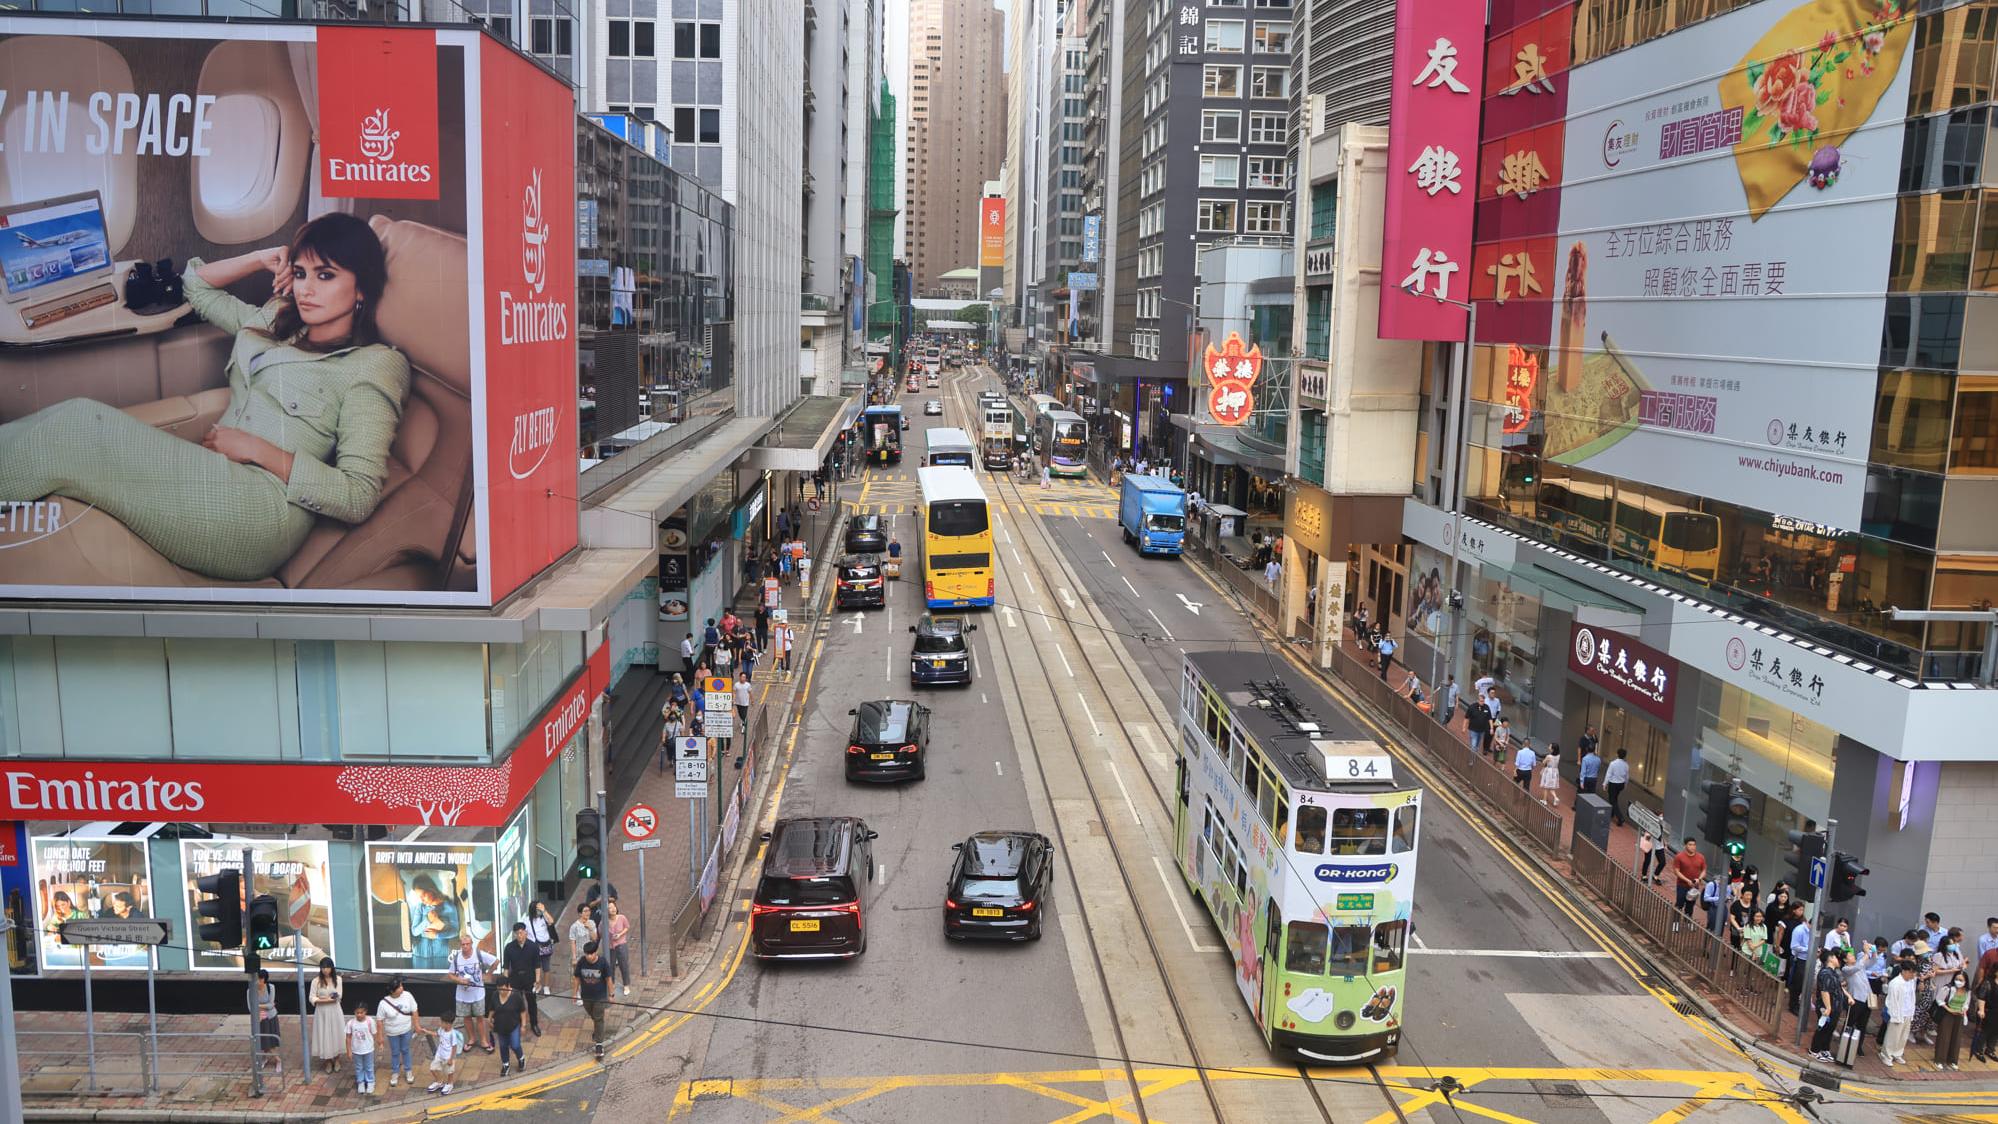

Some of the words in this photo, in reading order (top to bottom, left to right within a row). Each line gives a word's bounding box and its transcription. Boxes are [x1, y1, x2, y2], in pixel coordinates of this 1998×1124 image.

[1179, 5, 1199, 54] 錦記
[24, 90, 69, 153] IN
[86, 91, 216, 157] SPACE
[1660, 107, 1744, 159] 財富管理
[329, 158, 431, 182] Emirates
[1401, 37, 1471, 303] 友銀行
[1605, 217, 1734, 258] 全方位綜合服務
[1643, 261, 1787, 297] 照顧您全面需要
[500, 290, 567, 345] Emirates
[1215, 386, 1247, 418] 押
[1639, 392, 1717, 434] 工商服務
[513, 413, 527, 456] FLY
[529, 406, 554, 450] BETTER
[1787, 422, 1847, 448] 集友銀行
[1738, 456, 1843, 484] www.chiyubank.com
[1598, 638, 1667, 693] 集友銀行
[1750, 647, 1825, 697] 集友銀行
[545, 690, 585, 757] Emirates
[1348, 759, 1378, 777] 84
[6, 771, 205, 812] Emirates
[1300, 795, 1314, 805] 84
[1406, 795, 1417, 804] 84
[44, 847, 69, 859] LUNCH
[71, 847, 91, 860] DATE
[88, 860, 106, 872] FEET
[254, 862, 271, 874] YOU
[273, 862, 303, 874] BOARD
[375, 851, 395, 863] DRIFT
[397, 852, 412, 864] INTO
[414, 852, 446, 864] ANOTHER
[448, 853, 473, 864] WORLD
